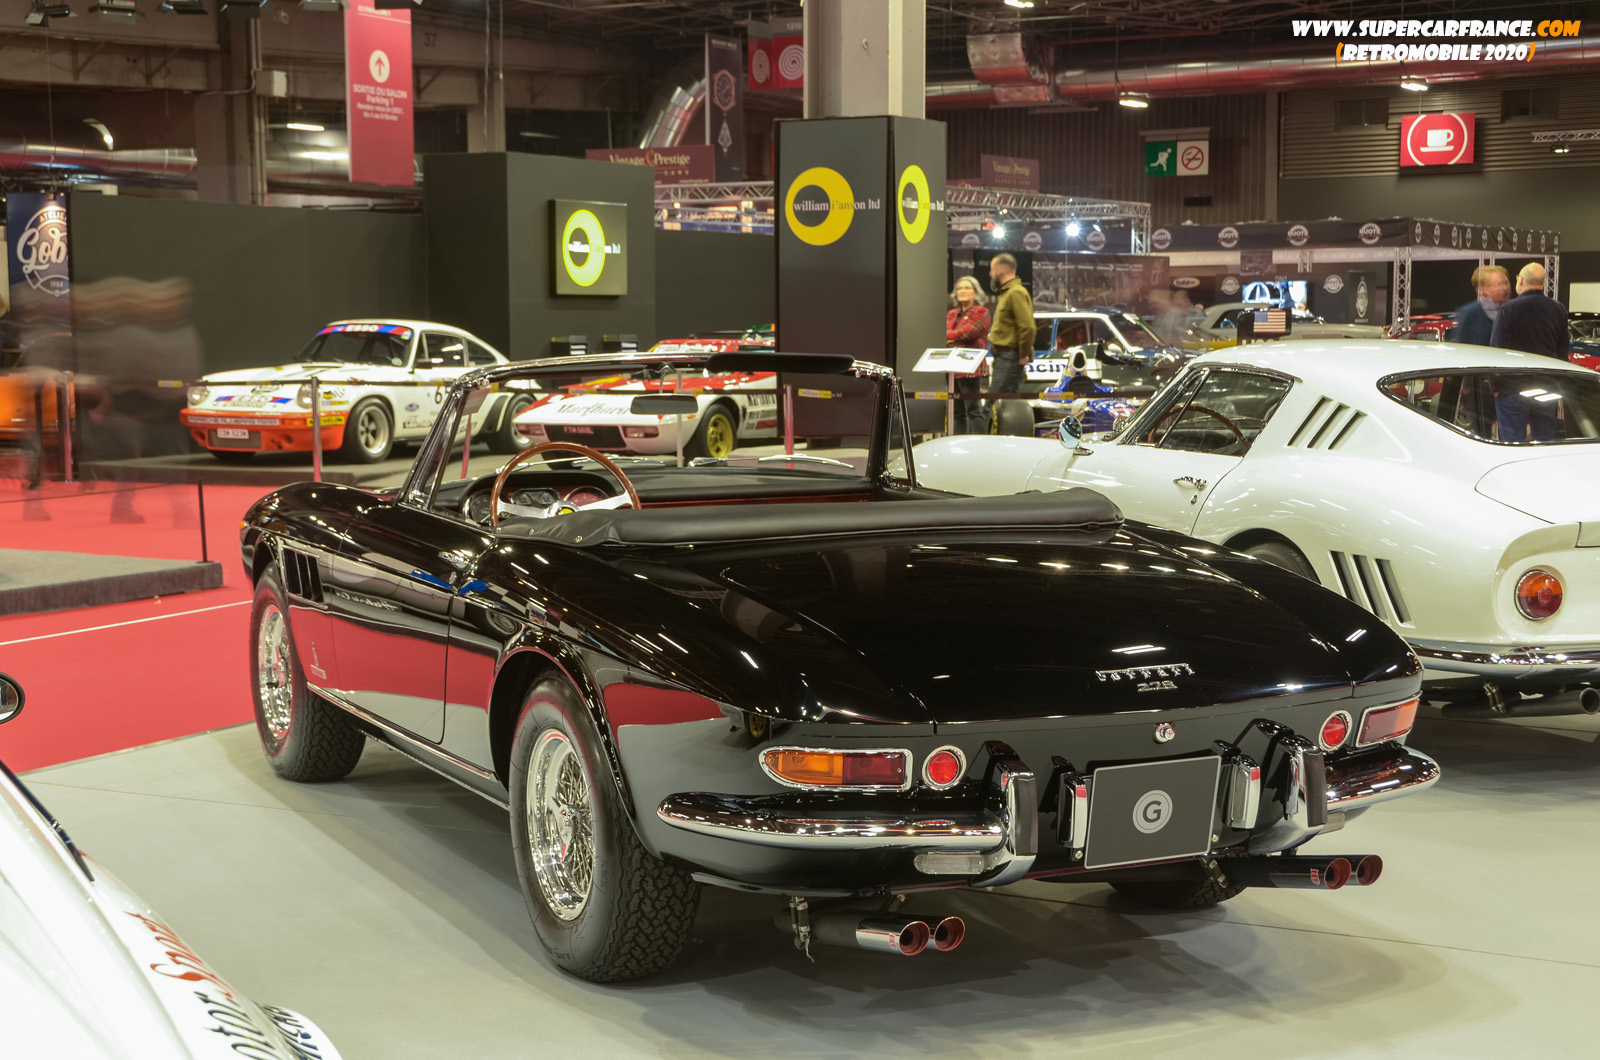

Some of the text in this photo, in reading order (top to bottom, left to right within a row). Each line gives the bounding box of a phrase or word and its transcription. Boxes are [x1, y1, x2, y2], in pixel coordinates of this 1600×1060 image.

[353, 84, 408, 99] SORTIE DU SALON
[366, 94, 390, 107] Parking
[654, 152, 691, 166] Prestige
[793, 200, 829, 212] william
[868, 198, 881, 210] ltd
[346, 324, 379, 333] ESSO
[557, 402, 630, 416] Marlboro
[1142, 800, 1163, 824] G
